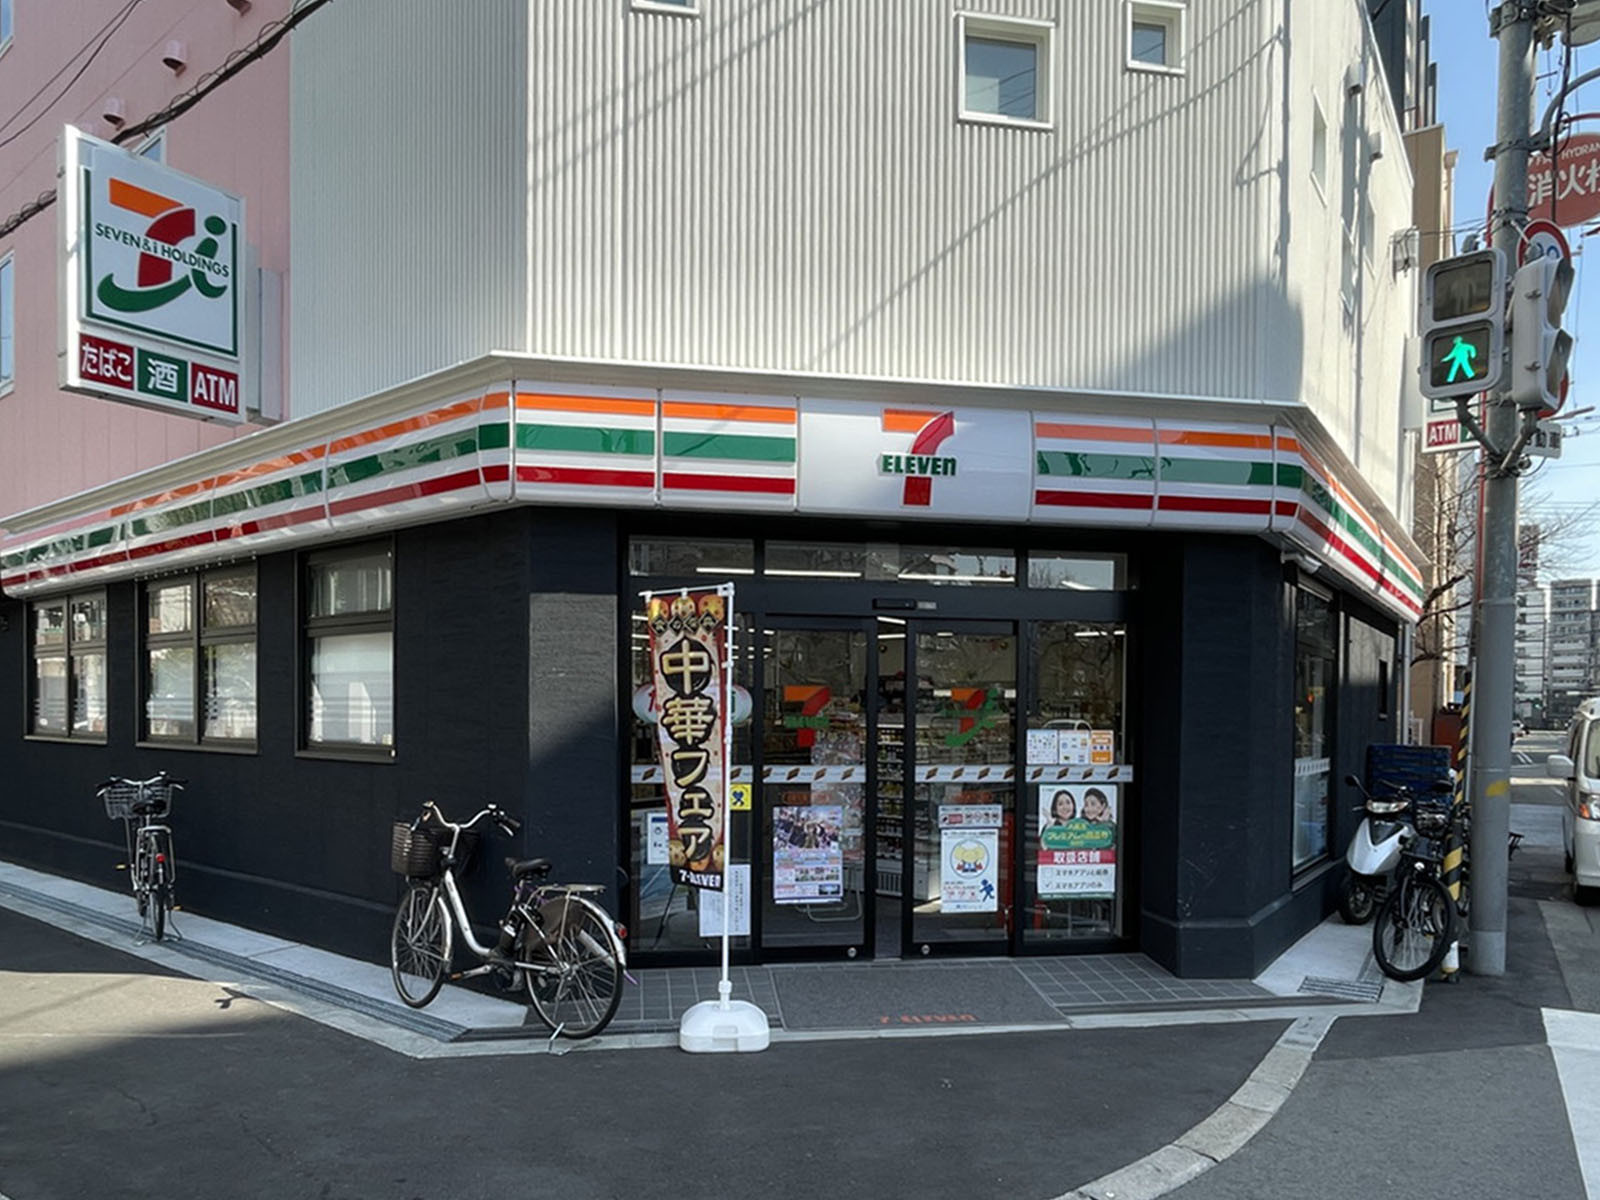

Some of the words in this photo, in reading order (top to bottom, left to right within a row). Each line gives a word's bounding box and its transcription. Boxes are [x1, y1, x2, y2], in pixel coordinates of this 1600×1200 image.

[161, 244, 230, 278] HOLDINGS
[82, 342, 132, 382] たばこ
[147, 358, 179, 394] 酒
[194, 371, 237, 408] ATM
[1428, 423, 1457, 443] ATM
[661, 638, 715, 860] 中華フェア
